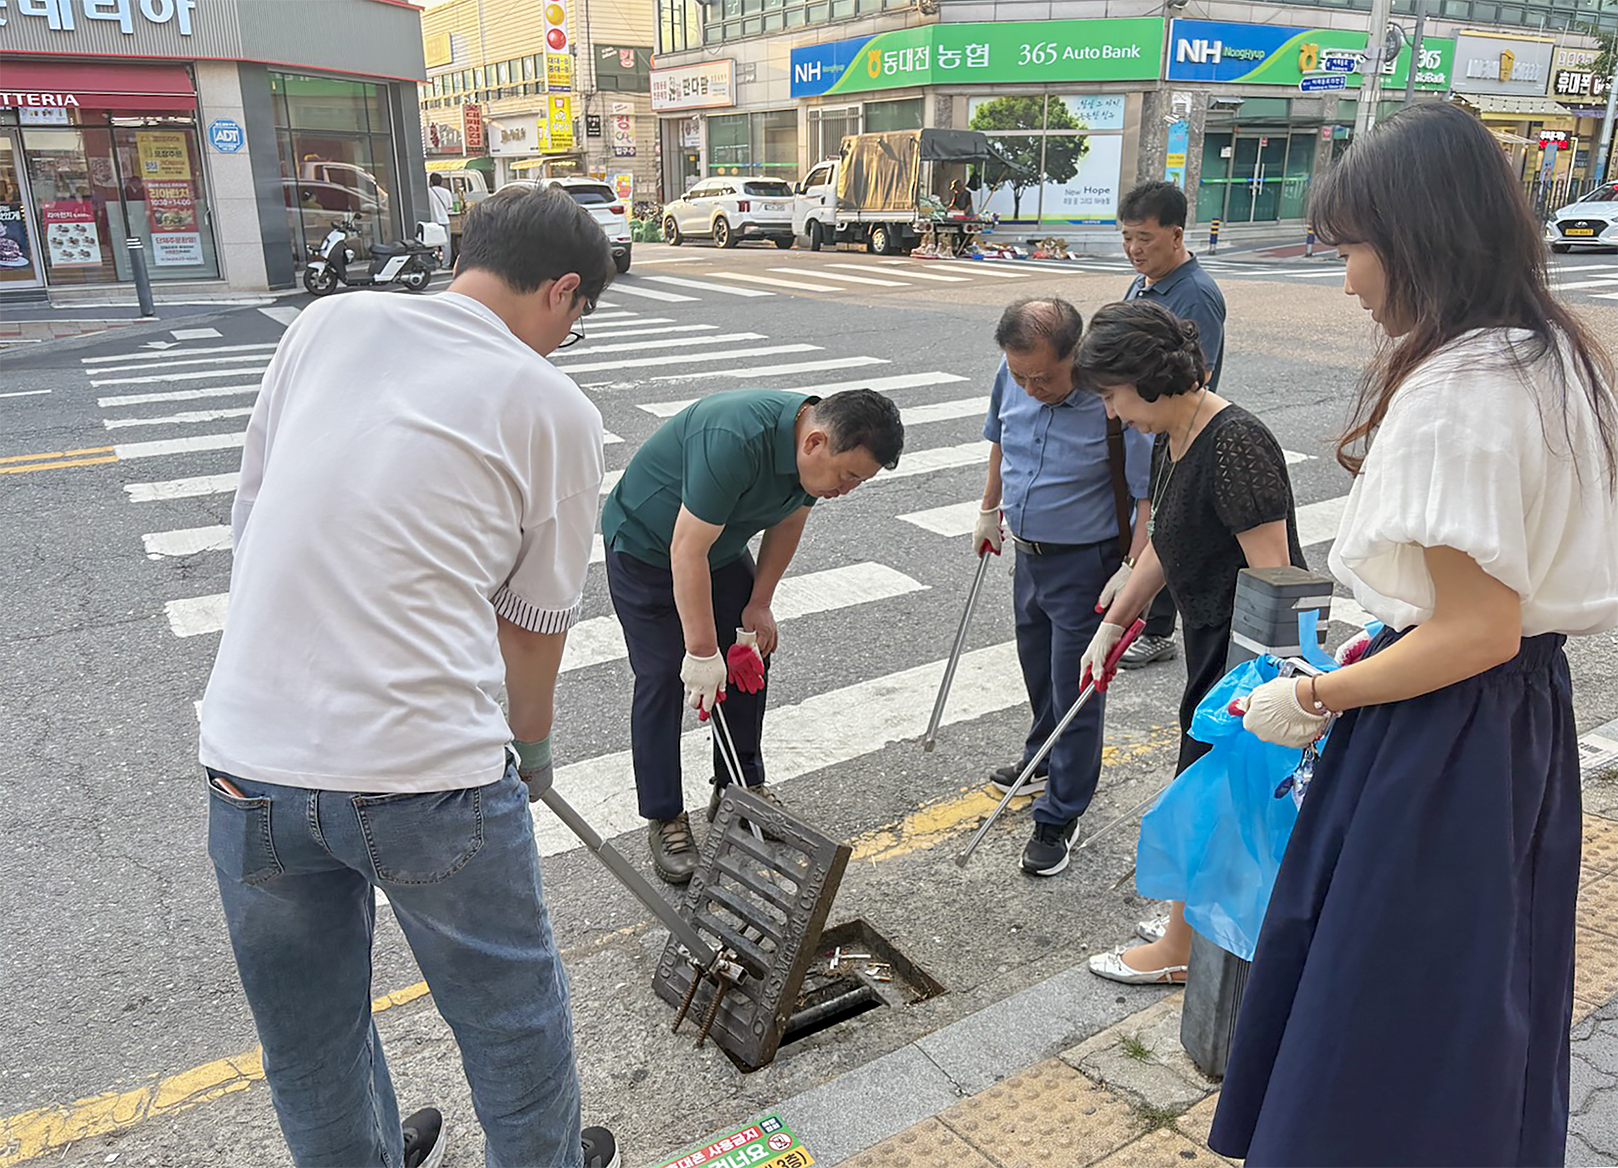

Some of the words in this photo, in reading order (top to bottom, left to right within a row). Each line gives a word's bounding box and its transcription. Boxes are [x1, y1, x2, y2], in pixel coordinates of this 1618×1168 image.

[0, 0, 196, 36] 데리아
[883, 45, 930, 75] 동대전
[937, 43, 990, 69] 농협
[1018, 42, 1058, 66] 365
[1176, 39, 1222, 64] NH
[1223, 46, 1265, 60] NongHyup
[1417, 49, 1442, 69] 365
[795, 61, 821, 84] NH
[1557, 71, 1591, 94] 휴대폰
[0, 92, 79, 106] TTERIA
[215, 129, 238, 142] ADT
[149, 188, 190, 199] 리아런치
[1064, 188, 1081, 196] New
[1083, 186, 1111, 196] Hope
[800, 863, 826, 911] Cover
[708, 1127, 759, 1158] 사용금지
